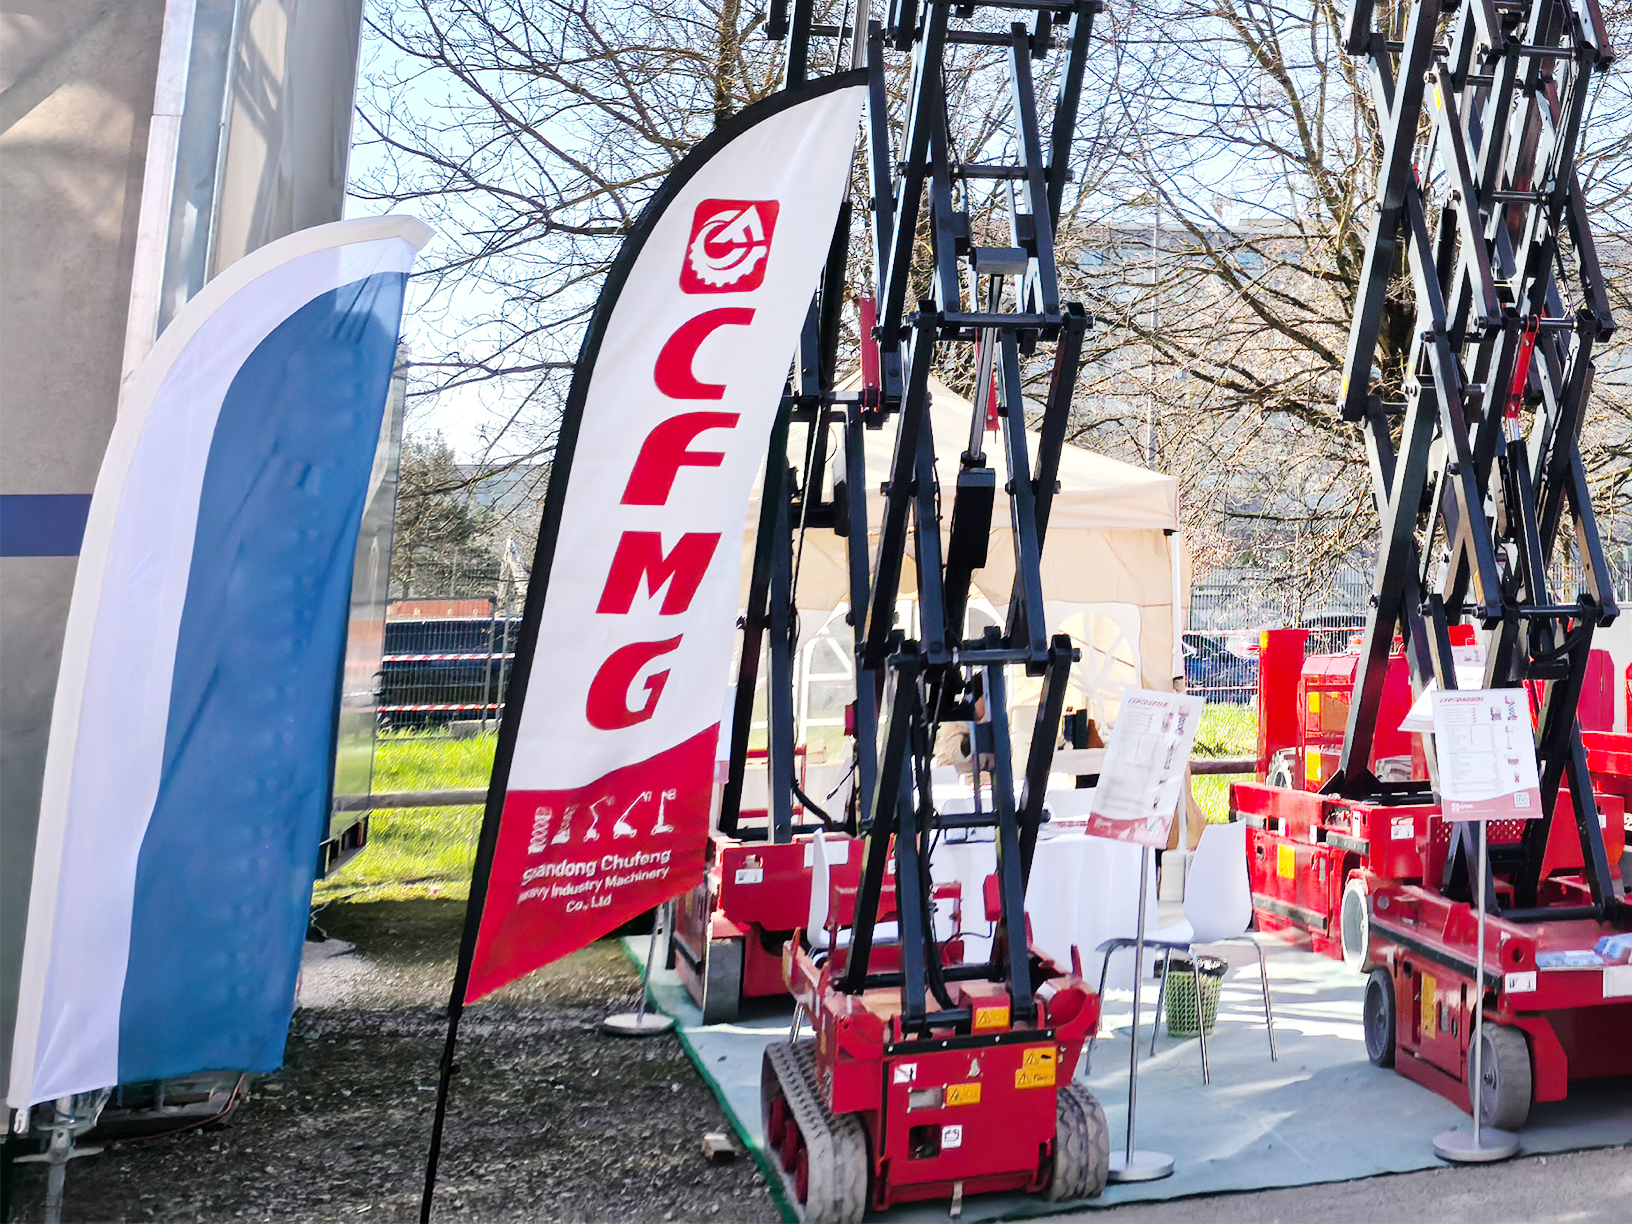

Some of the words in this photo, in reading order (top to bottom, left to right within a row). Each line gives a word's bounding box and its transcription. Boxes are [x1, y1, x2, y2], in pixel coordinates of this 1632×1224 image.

[586, 307, 758, 731] CFMG
[601, 849, 672, 871] Chufeng
[551, 878, 603, 898] Industry
[605, 866, 670, 889] Machinery
